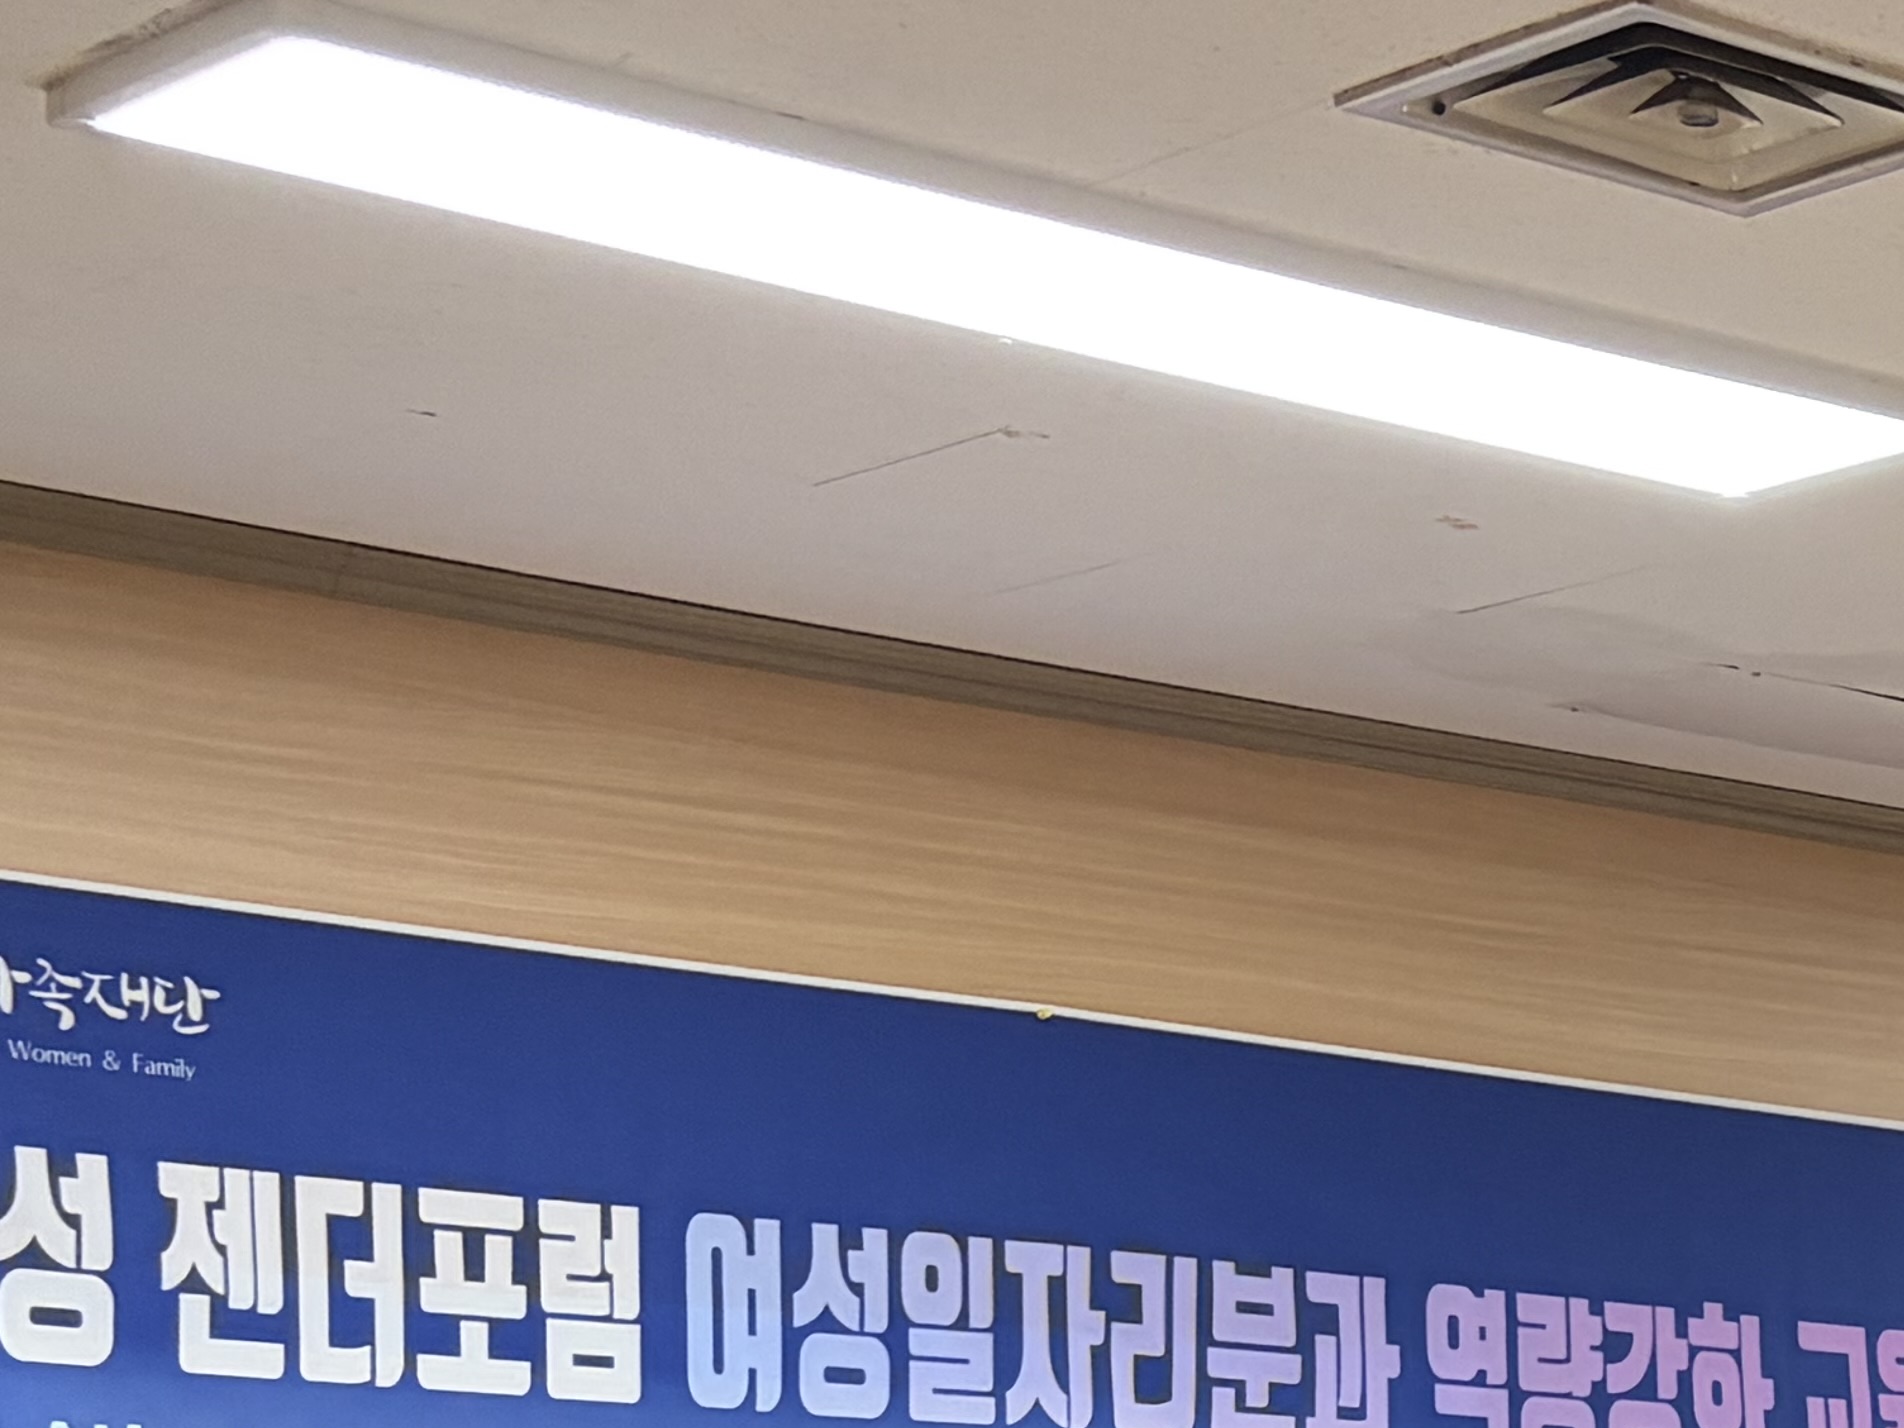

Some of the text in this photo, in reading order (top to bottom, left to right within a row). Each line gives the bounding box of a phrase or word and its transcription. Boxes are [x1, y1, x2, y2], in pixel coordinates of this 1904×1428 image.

[7, 1039, 91, 1072] Women
[131, 1051, 197, 1082] Family
[157, 1159, 644, 1405] 젠더포럼
